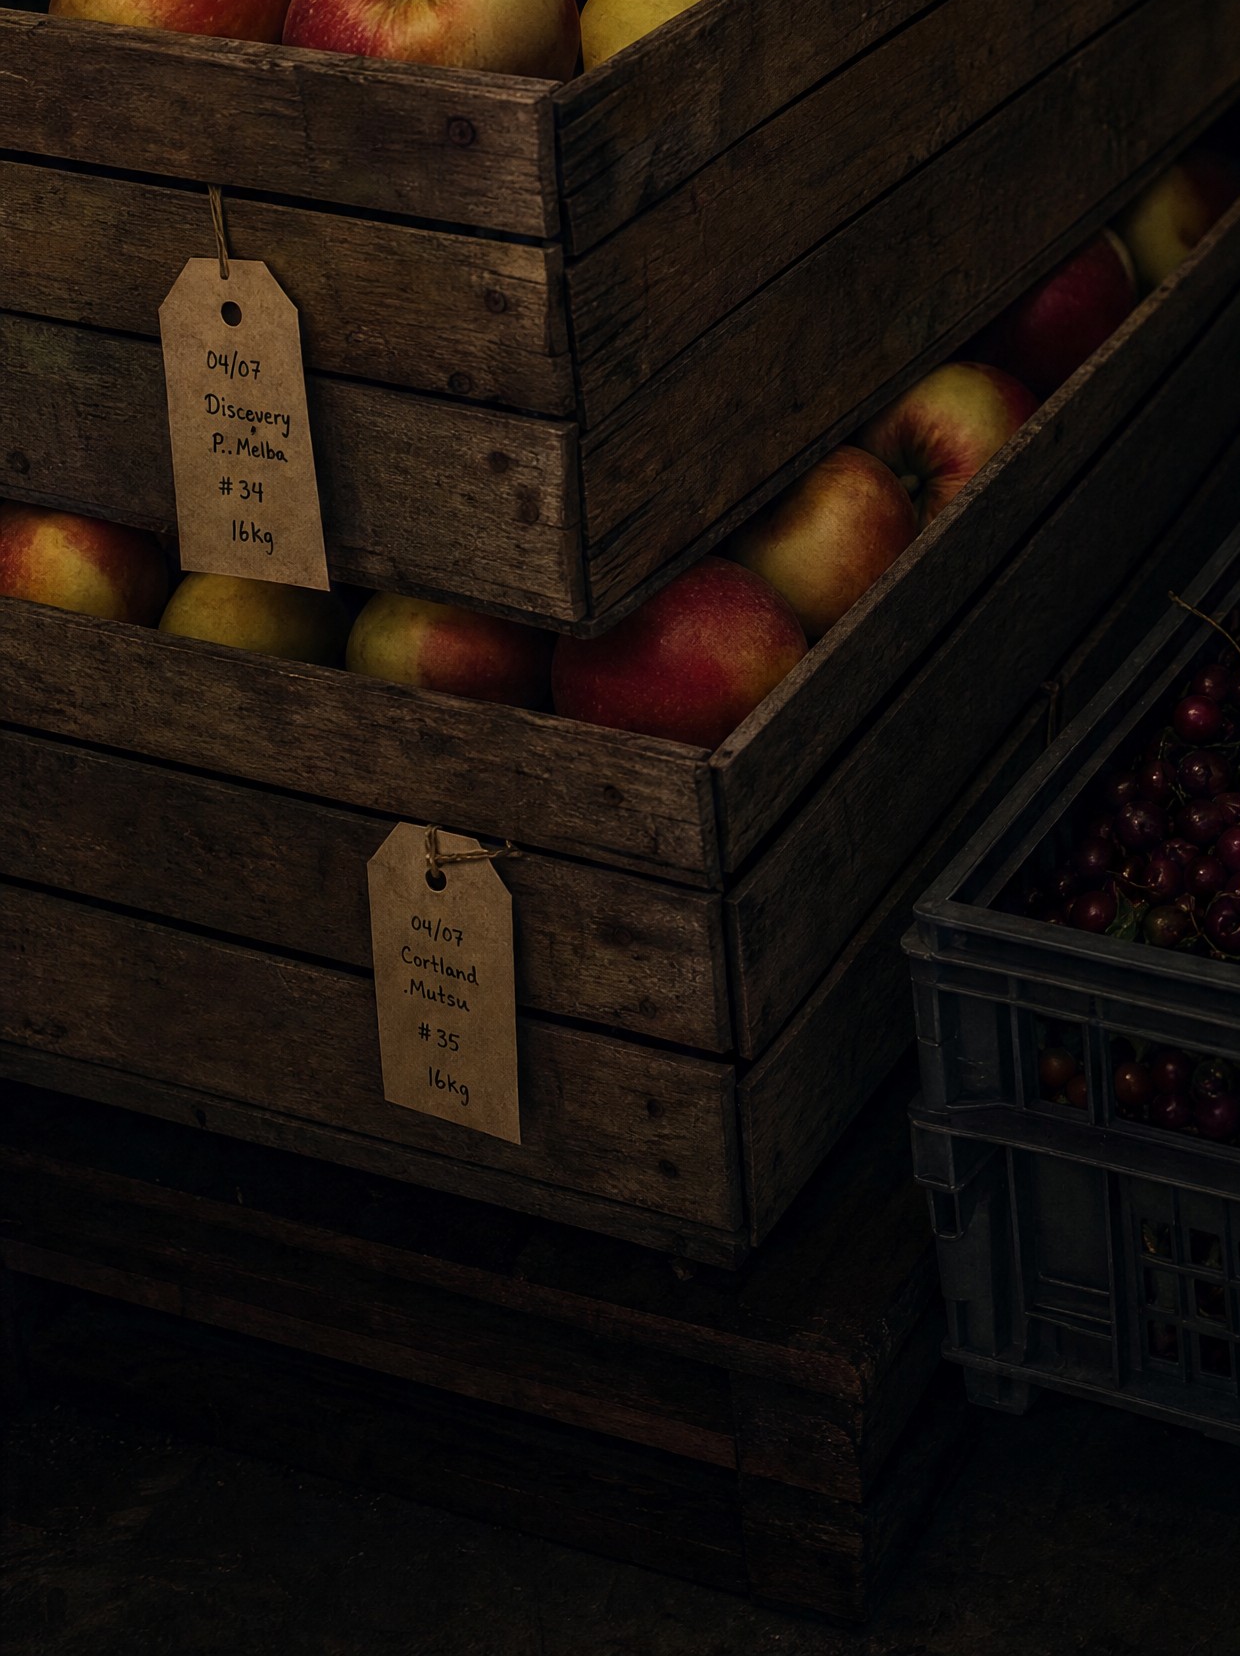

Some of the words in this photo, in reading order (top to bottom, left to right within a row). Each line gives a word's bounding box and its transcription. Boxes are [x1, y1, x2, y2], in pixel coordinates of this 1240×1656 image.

[207, 350, 260, 380] 04/07
[235, 437, 289, 463] Melba
[233, 520, 273, 555] 16kg
[411, 915, 463, 946] 04/07
[402, 943, 479, 989] Cortland
[429, 1066, 469, 1106] 16kg
